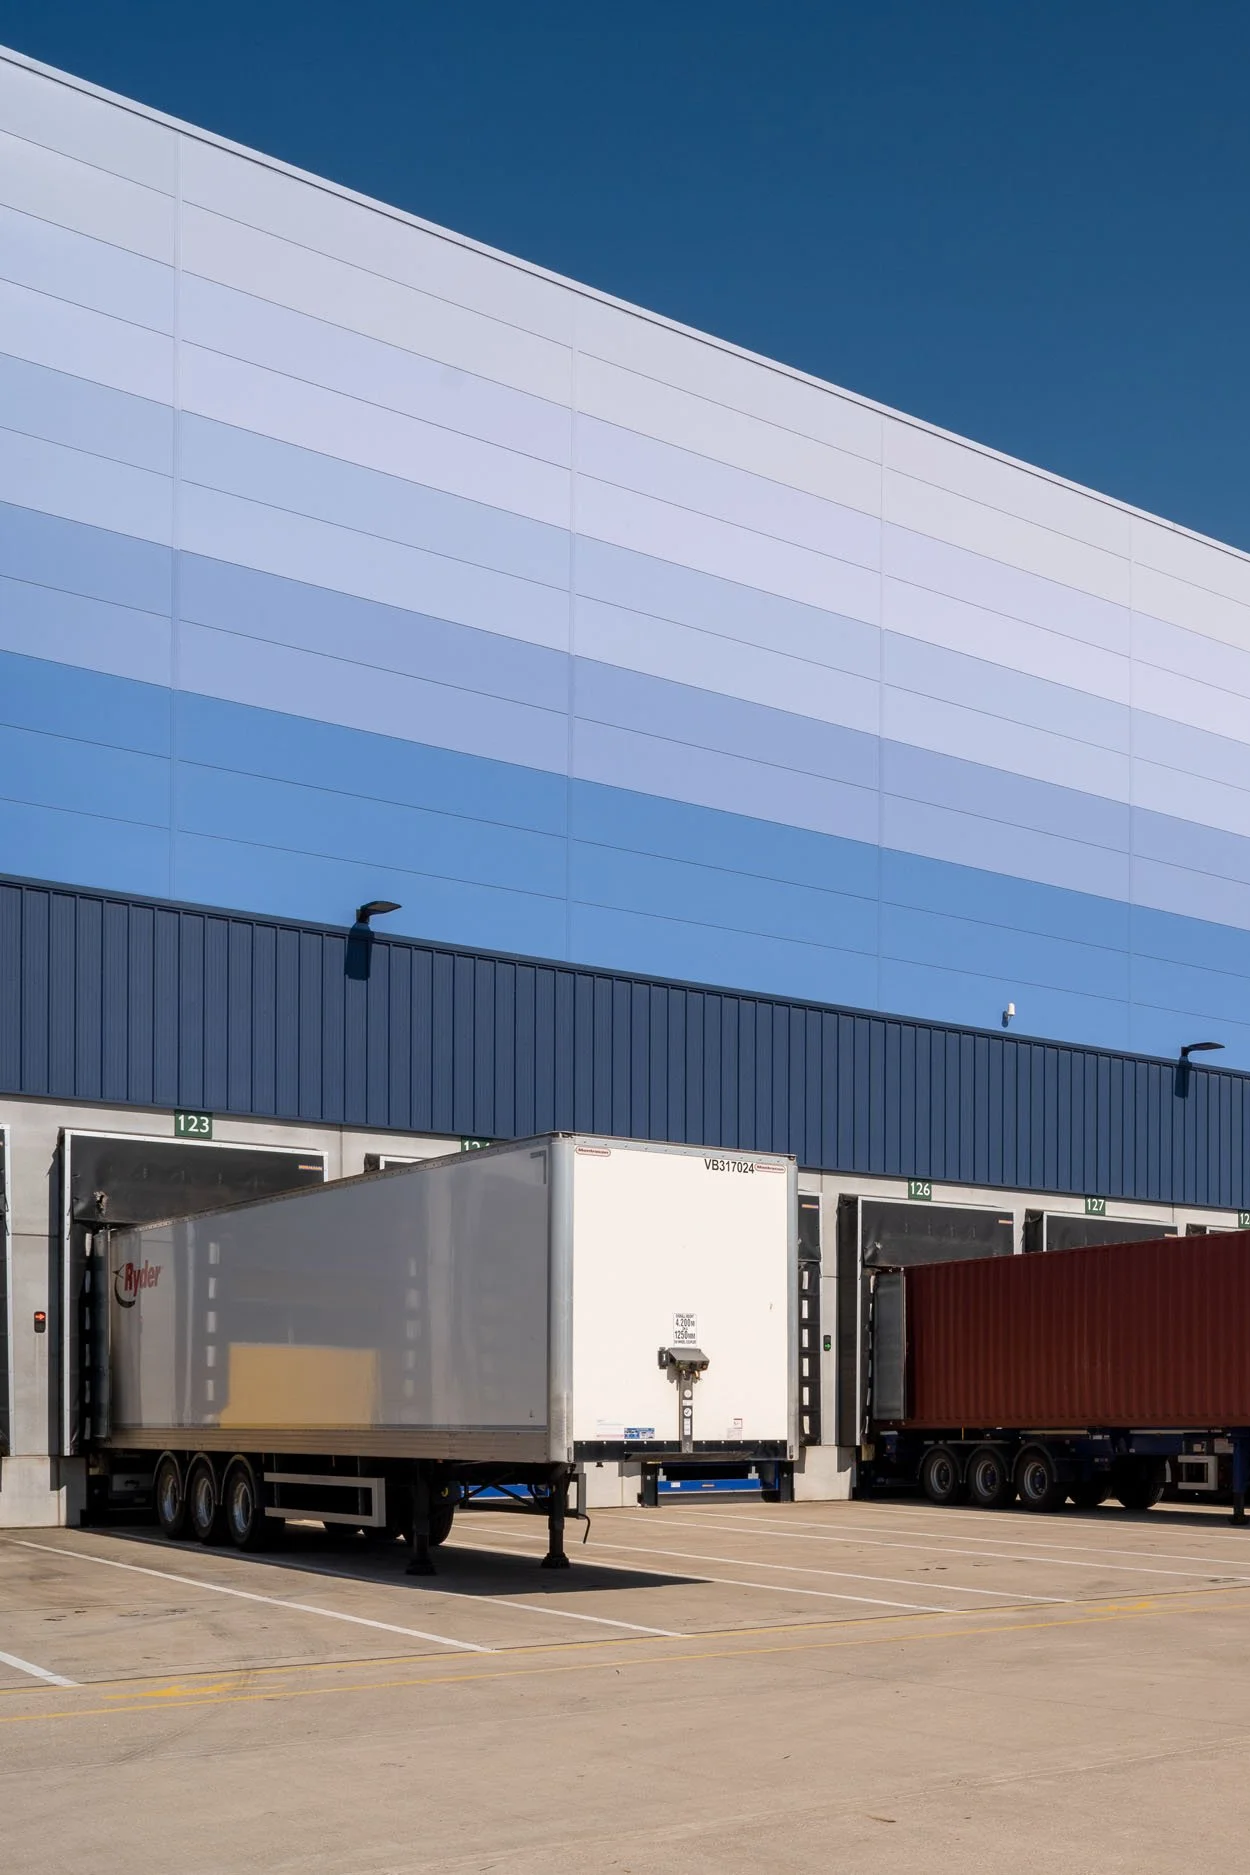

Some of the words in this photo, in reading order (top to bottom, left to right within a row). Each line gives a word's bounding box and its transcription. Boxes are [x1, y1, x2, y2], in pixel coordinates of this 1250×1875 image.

[178, 1114, 210, 1133] 123
[464, 1141, 490, 1151] 12
[704, 1159, 755, 1174] VB317024
[910, 1182, 931, 1196] 126
[1087, 1198, 1105, 1211] 127
[124, 1260, 162, 1297] Ryder
